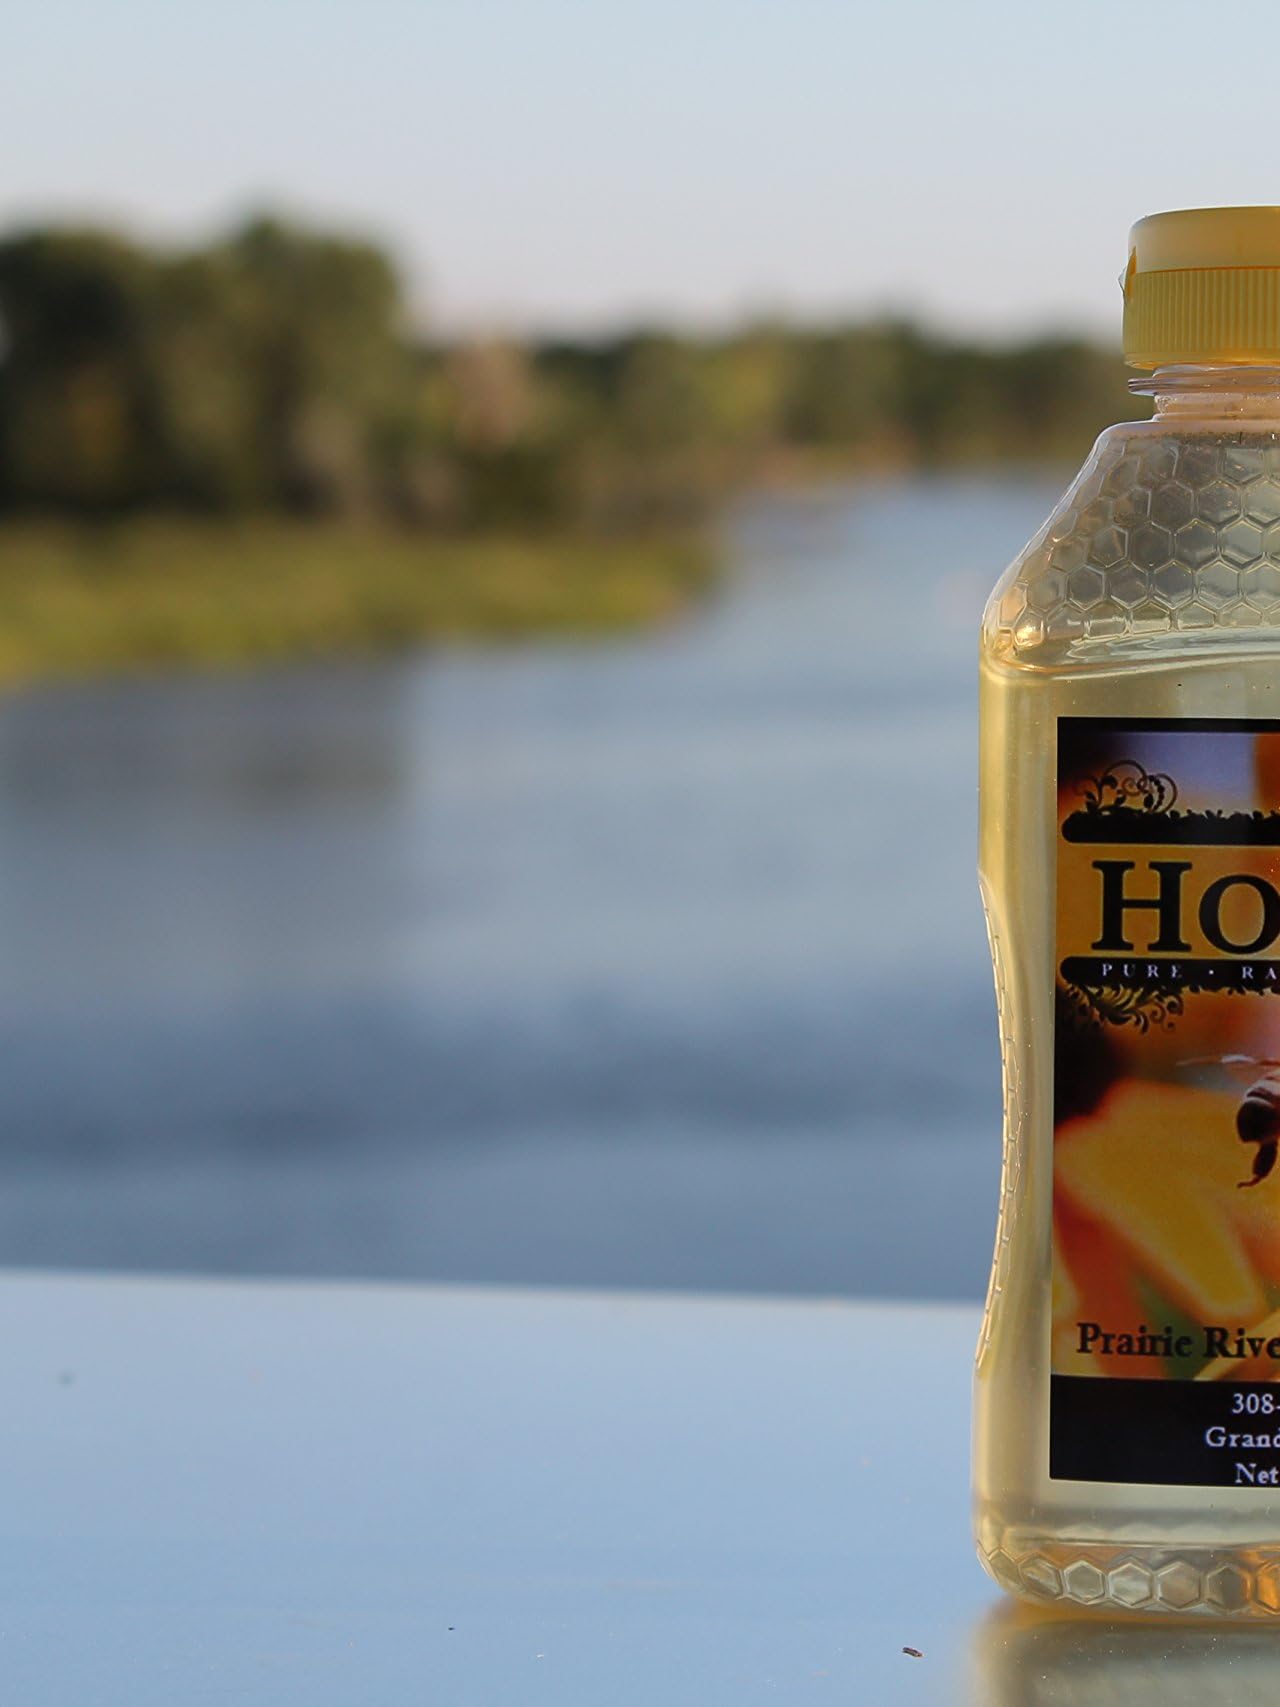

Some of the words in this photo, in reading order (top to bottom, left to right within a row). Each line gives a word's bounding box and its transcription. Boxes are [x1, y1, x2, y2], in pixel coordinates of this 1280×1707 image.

[1101, 963, 1184, 979] PURE
[1077, 1323, 1193, 1358] Prairie
[1234, 1463, 1279, 1485] Net
